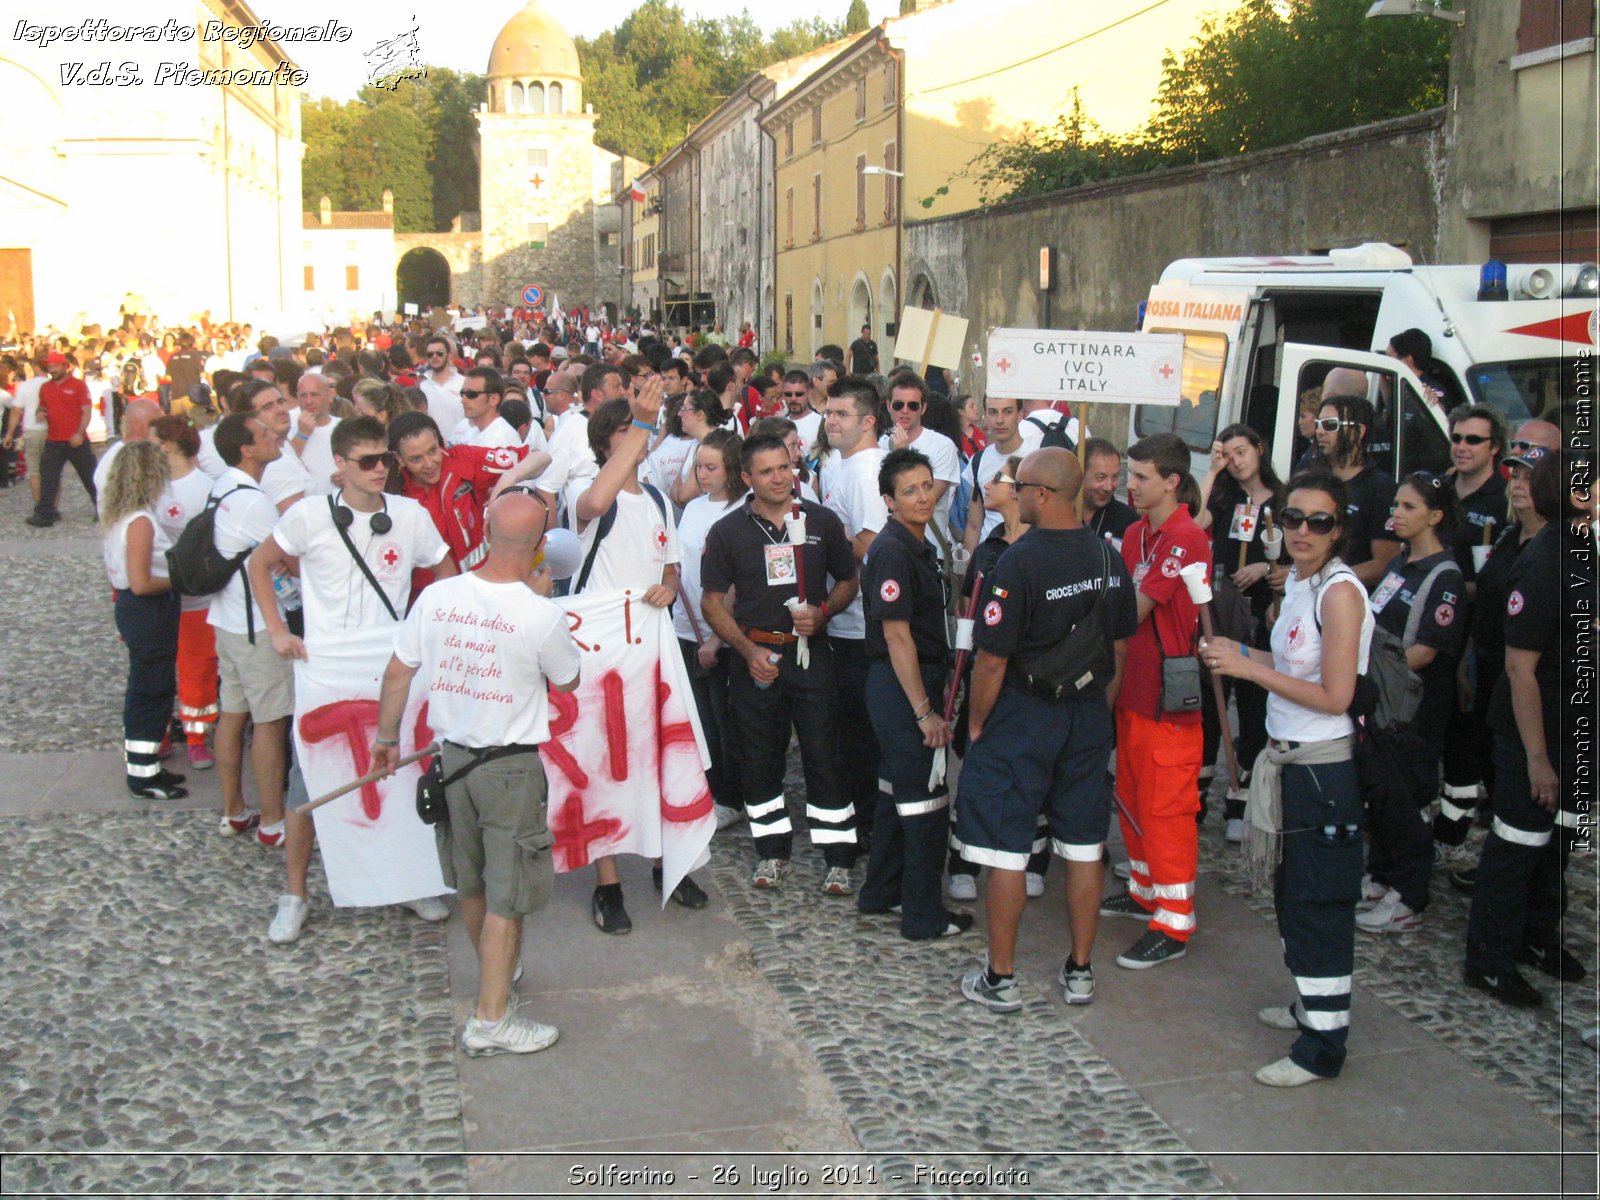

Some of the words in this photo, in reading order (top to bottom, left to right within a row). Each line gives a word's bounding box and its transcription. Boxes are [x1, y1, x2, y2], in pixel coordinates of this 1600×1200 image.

[1183, 302, 1242, 321] ITALIANA
[1033, 342, 1136, 358] GATTINARA
[1063, 361, 1103, 376] (VC)
[1059, 378, 1108, 392] ITALY
[1046, 586, 1073, 600] CROCE
[1073, 579, 1093, 594] ROSSA
[444, 634, 461, 648] sta
[465, 640, 496, 660] maja
